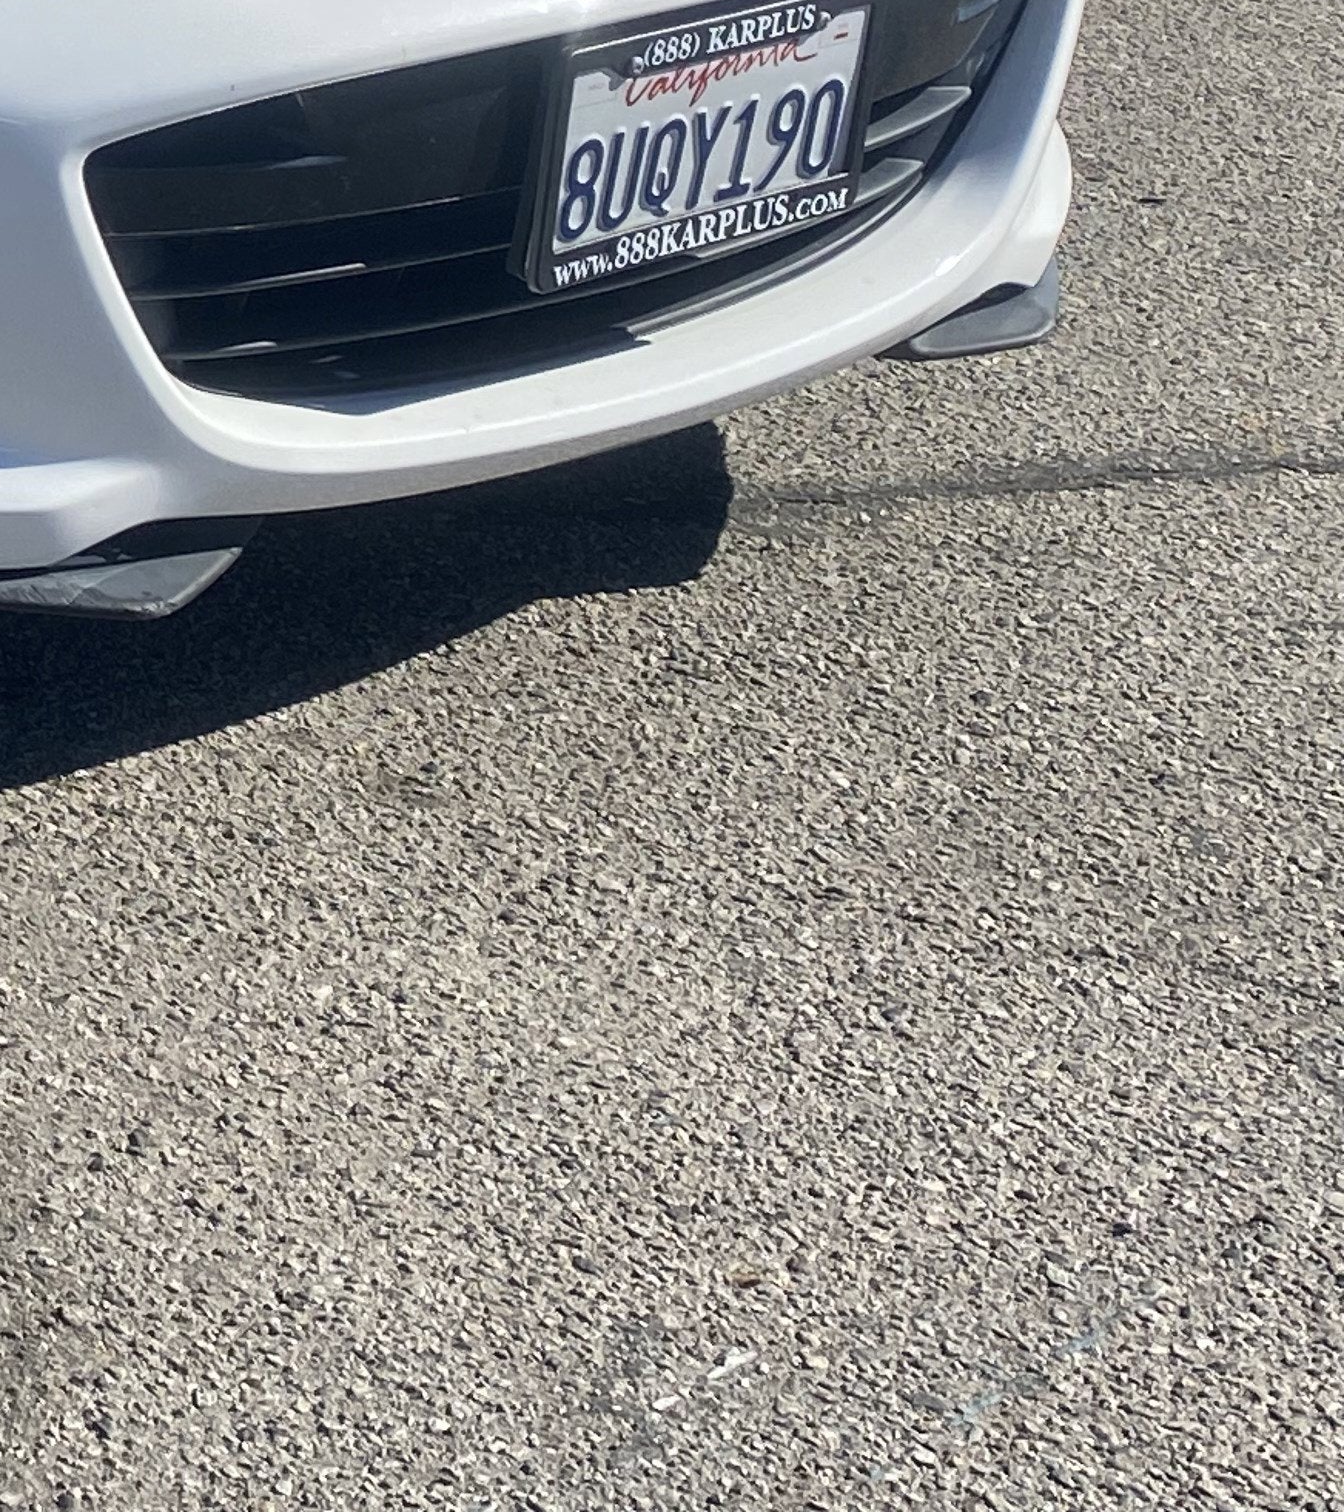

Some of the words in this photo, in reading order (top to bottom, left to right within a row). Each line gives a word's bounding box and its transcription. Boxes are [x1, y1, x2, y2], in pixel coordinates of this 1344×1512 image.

[644, 32, 701, 67] (888)
[707, 4, 816, 55] KARPLUS
[625, 39, 818, 107] California
[556, 79, 845, 242] 8UQY190
